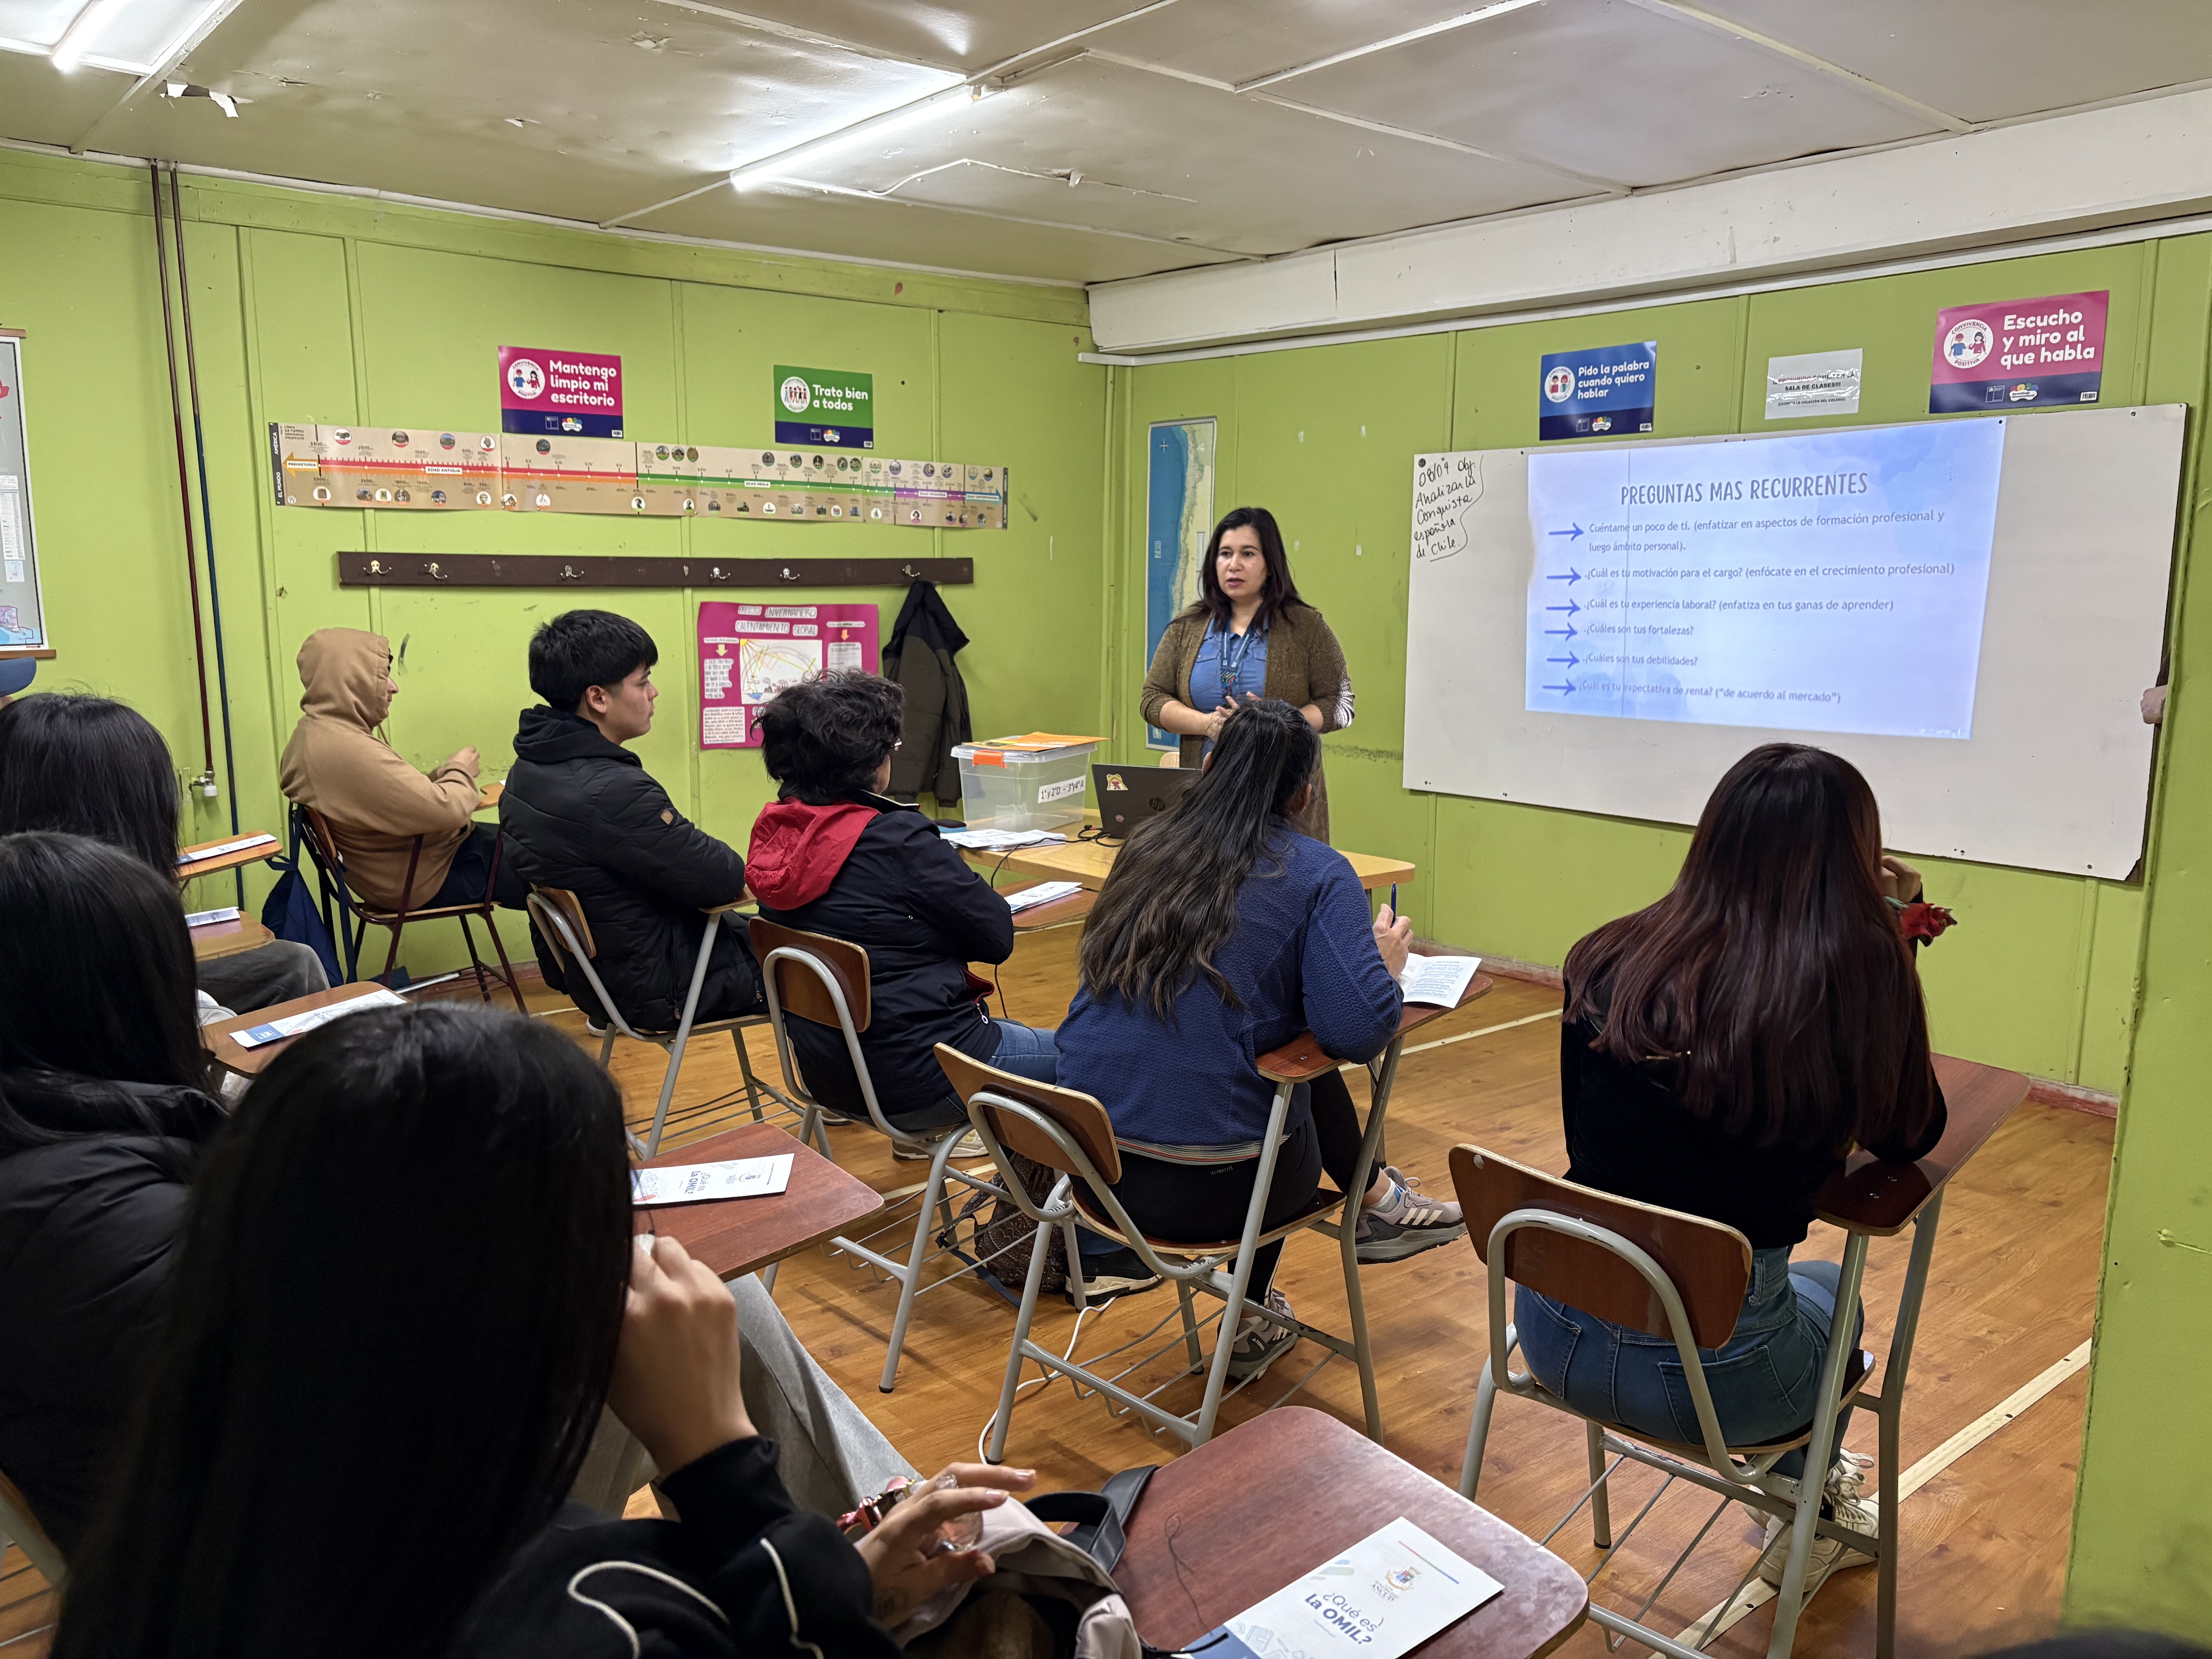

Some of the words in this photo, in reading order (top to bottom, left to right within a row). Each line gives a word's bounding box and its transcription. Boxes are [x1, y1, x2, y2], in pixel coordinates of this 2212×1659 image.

[1951, 321, 1987, 335] CONVIVENCIA
[2003, 308, 2083, 331] Escucho
[2002, 335, 2014, 352] y
[2018, 330, 2061, 347] miro
[2066, 325, 2085, 342] al
[1954, 357, 1980, 367] POSITIVA
[2000, 352, 2035, 370] que
[2039, 343, 2095, 363] habla
[549, 359, 617, 380] Mantengo
[1578, 366, 1599, 377] Pido
[1601, 364, 1610, 374] la
[1612, 360, 1650, 376] palabra
[550, 374, 591, 392] limpio
[593, 379, 609, 392] mi
[1578, 375, 1613, 388] cuando
[1614, 373, 1645, 386] quiero
[551, 392, 615, 407] escritorio
[812, 384, 843, 398] Trato
[845, 387, 869, 400] bien
[1577, 388, 1609, 400] hablar
[812, 399, 820, 408] a
[822, 397, 854, 411] todos
[1419, 461, 1449, 487] 08/04
[1415, 481, 1464, 509] Analizar
[1465, 476, 1476, 488] la
[1621, 483, 1703, 505] PREGUNTAS
[1709, 481, 1743, 502] MAS
[1750, 472, 1868, 500] RECURRENTES
[1417, 495, 1473, 525] Conquista
[1589, 522, 1630, 532] Cuéntame
[1645, 524, 1665, 533] poco
[1667, 521, 1678, 531] de
[1694, 519, 1738, 532] (enfatizar
[1741, 520, 1752, 529] en
[1755, 517, 1797, 529] aspectos
[1800, 516, 1813, 526] de
[1816, 512, 1869, 526] formación
[1872, 509, 1934, 525] profesional
[1937, 510, 1945, 522] y
[1414, 518, 1456, 547] española
[1416, 544, 1426, 558] de
[1589, 542, 1611, 553] luego
[1613, 542, 1642, 551] ámbito
[1644, 541, 1686, 553] personal).
[1622, 568, 1631, 577] tu
[1632, 567, 1678, 578] motivación
[1680, 570, 1700, 580] para
[1702, 567, 1711, 577] el
[1714, 568, 1743, 579] cargo?
[1745, 566, 1792, 579] (enfócate
[1794, 568, 1807, 577] en
[1809, 565, 1819, 575] el
[1822, 565, 1885, 575] crecimiento
[1887, 563, 1954, 577] profesional)
[1621, 599, 1629, 608] tu
[1631, 599, 1680, 610] experiencia
[1682, 601, 1716, 610] laboral?
[1719, 600, 1760, 611] (enfatiza
[1762, 602, 1775, 610] en
[1778, 601, 1792, 610] tus
[1795, 603, 1823, 612] ganas
[1826, 599, 1839, 610] de
[1841, 600, 1894, 612] aprender)
[737, 622, 789, 633] CALENTAMIENTO
[794, 625, 817, 635] GLOBAL
[1634, 625, 1646, 634] tus
[1649, 625, 1694, 635] fortalezas?
[1632, 655, 1645, 664] tus
[1647, 655, 1698, 666] debilidades?
[1613, 682, 1621, 691] tu
[1623, 683, 1671, 694] expectativa
[1673, 685, 1683, 694] de
[1686, 686, 1712, 696] renta?
[1737, 690, 1774, 699] acuerdo
[1776, 691, 1786, 700] al
[1305, 1593, 1322, 1610] la
[1323, 1609, 1372, 1644] OMIL?
[1323, 1593, 1362, 1619] ¿Qué
[1360, 1618, 1377, 1632] es
